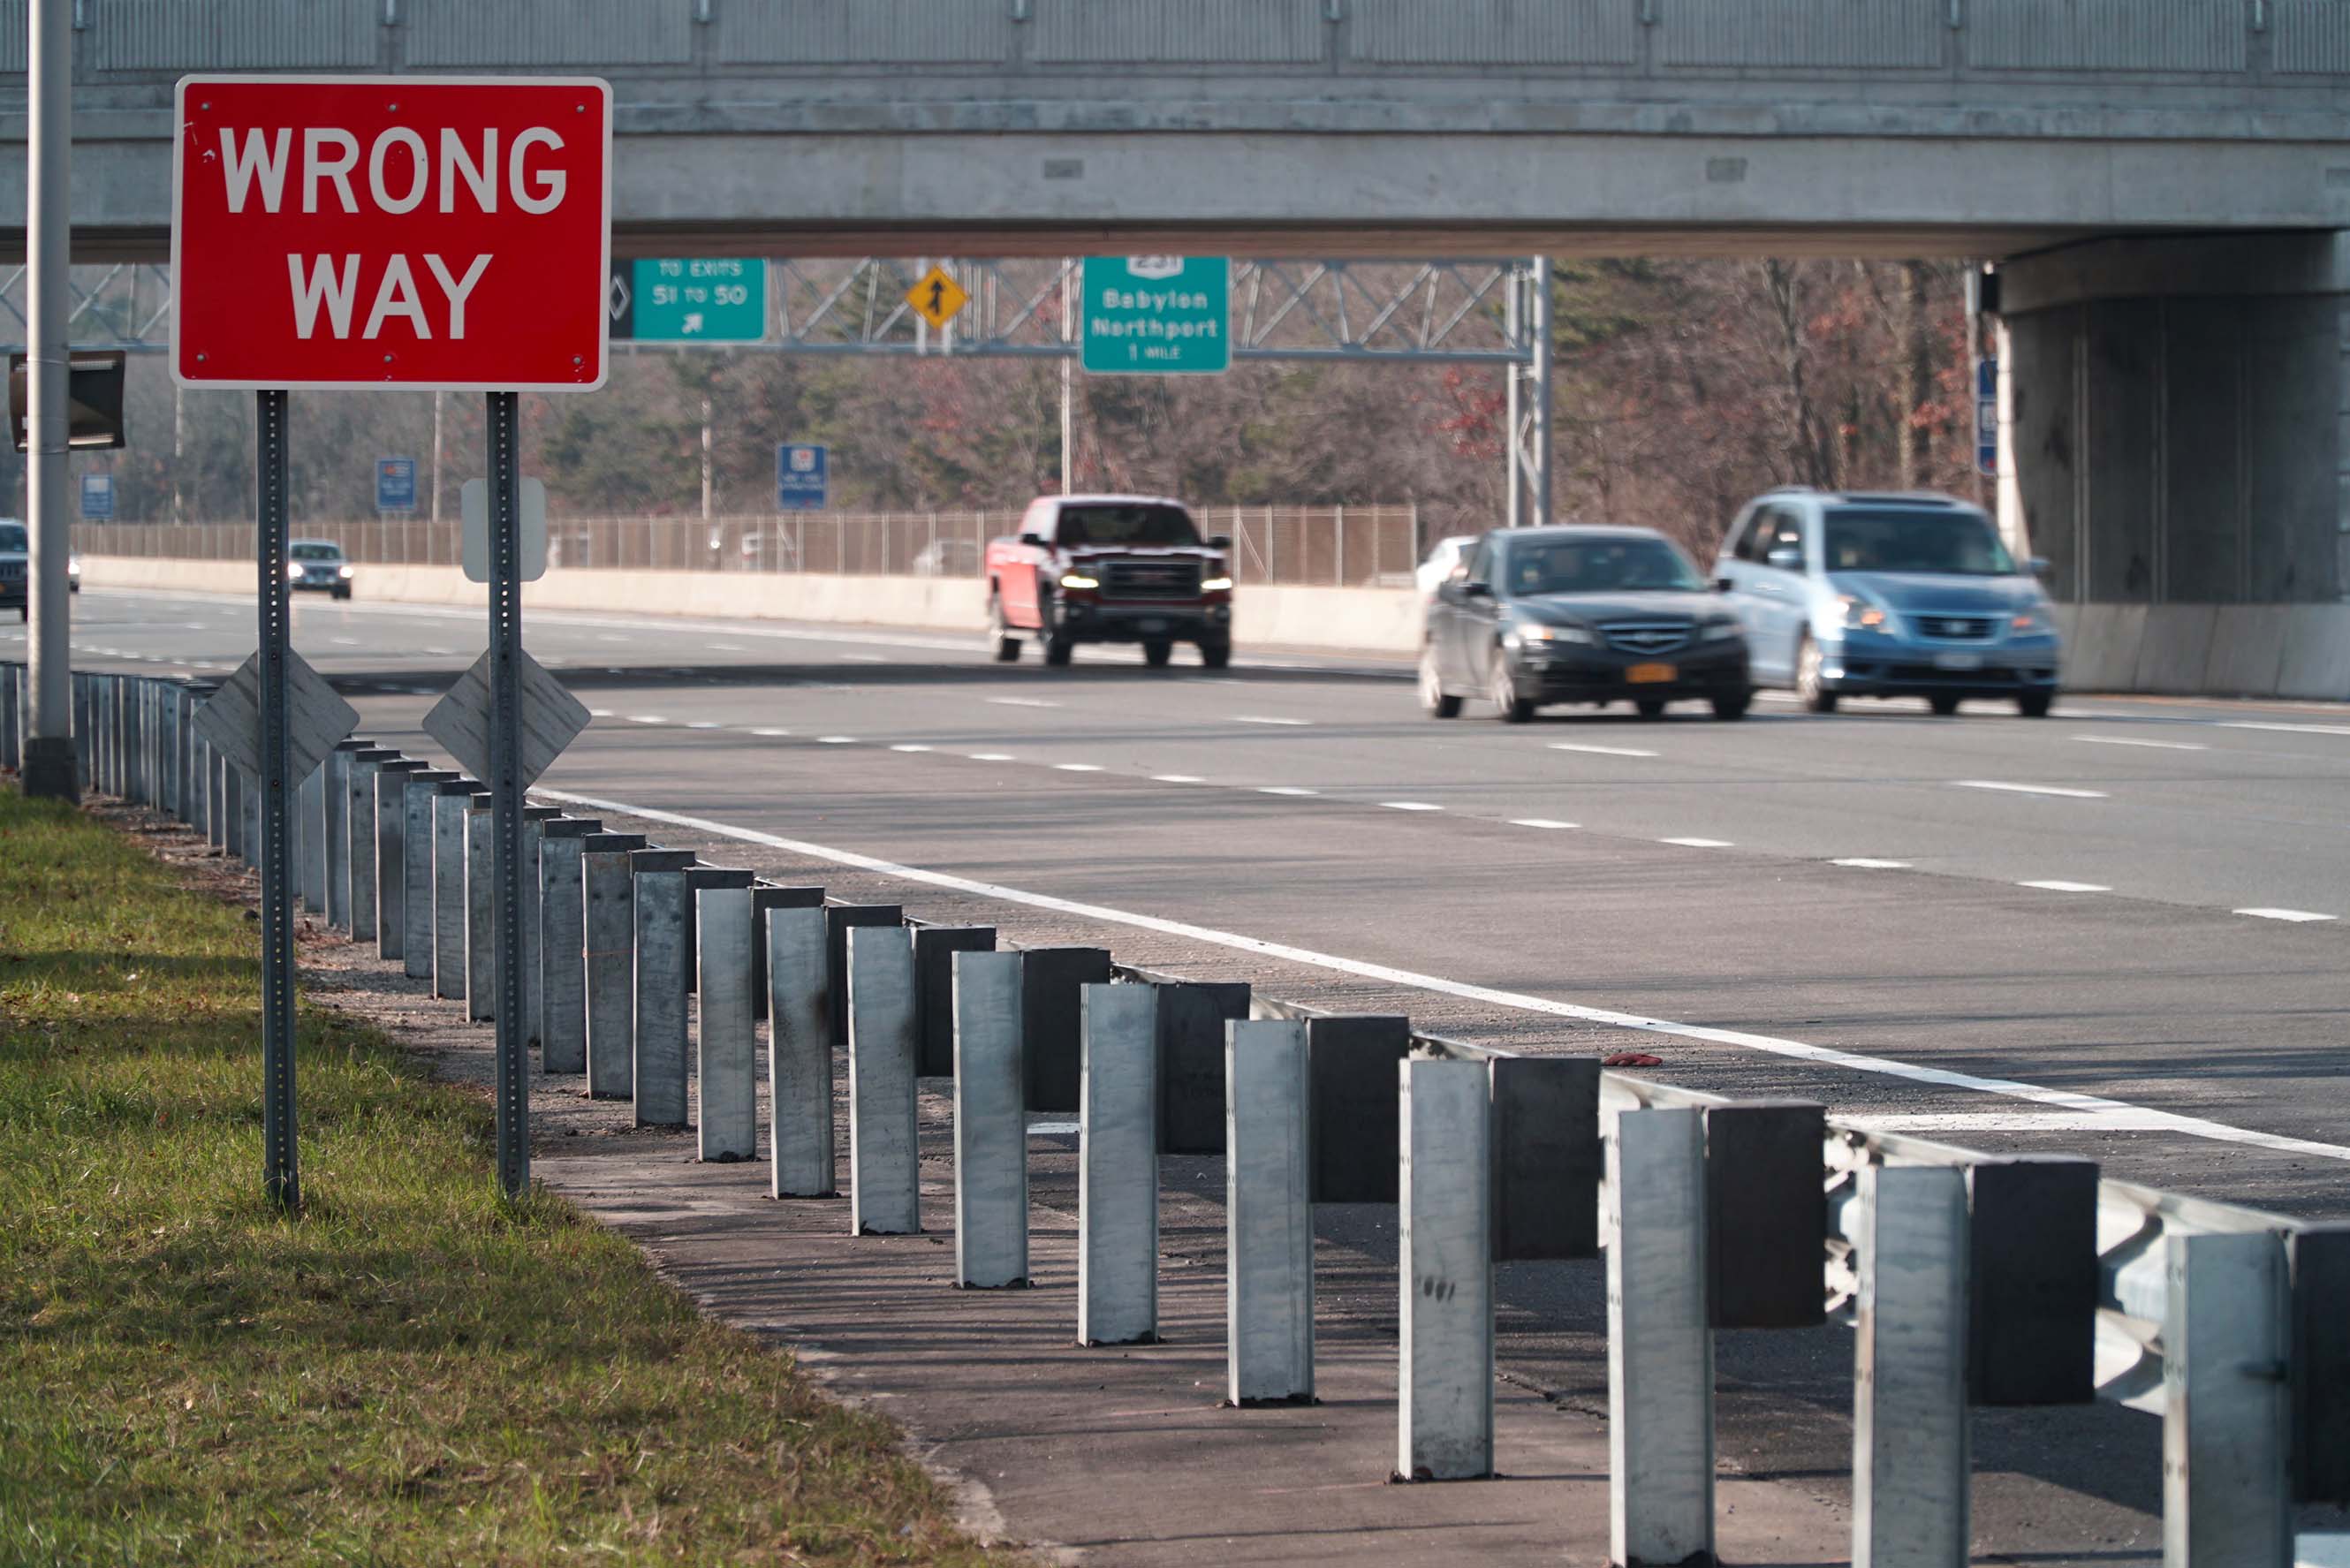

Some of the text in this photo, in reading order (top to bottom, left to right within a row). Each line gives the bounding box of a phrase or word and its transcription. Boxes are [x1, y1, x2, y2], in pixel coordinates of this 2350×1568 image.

[219, 126, 567, 215] WRONG
[659, 260, 743, 277] TO EXITS
[287, 254, 494, 339] WAY
[652, 284, 748, 305] 51 TO 50
[1103, 288, 1208, 313] Babylon
[1091, 317, 1217, 341] Northport
[1128, 344, 1180, 360] 1 MILE
